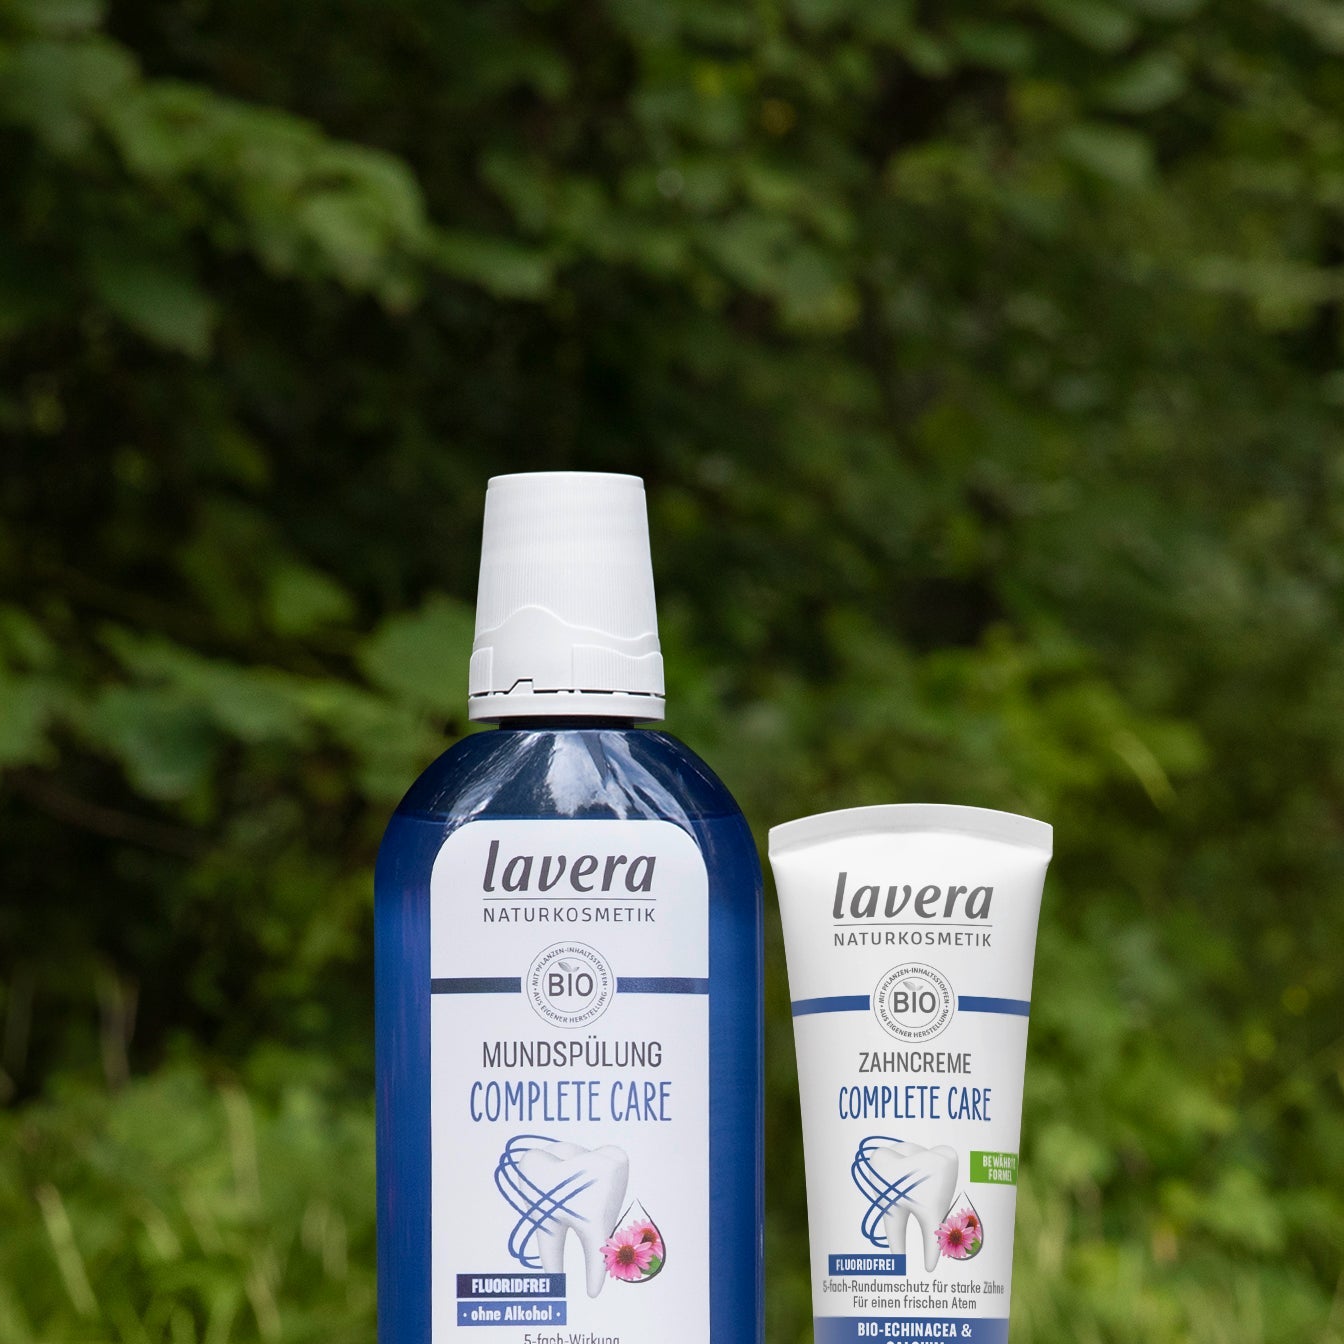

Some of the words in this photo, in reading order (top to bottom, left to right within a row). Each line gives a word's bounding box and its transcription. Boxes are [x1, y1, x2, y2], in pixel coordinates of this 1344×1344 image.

[483, 840, 656, 892] lavera
[833, 872, 994, 919] lavera
[483, 907, 655, 922] NATURKOSMETIK
[834, 931, 992, 947] NATURKOSMETIK
[536, 947, 608, 986] PFLANZEN-INHALTSSTOFFEN
[548, 973, 593, 996] BIO
[882, 967, 950, 1004] PFLANZEN-INHALTSSTOFFEN
[533, 991, 542, 1006] AUS
[540, 1005, 568, 1023] EIGENER
[569, 991, 607, 1023] HERSTELLUNG
[893, 991, 936, 1014] BIO
[880, 1008, 888, 1022] AUS
[886, 1020, 912, 1038] EIGENER
[913, 1009, 949, 1038] HERSTELLUNG
[483, 1035, 662, 1067] MUNDSPÜLUNG
[858, 1051, 972, 1074] ZAHNCREME
[470, 1081, 601, 1122] COMPLETE
[610, 1081, 672, 1122] CARE
[839, 1085, 941, 1120] COMPLETE
[947, 1086, 992, 1121] CARE
[836, 1258, 895, 1271] FLUORIDFREI
[471, 1278, 551, 1294] FLUORIDFREI
[822, 1279, 930, 1294] 5-fach-Rundumschutz
[932, 1280, 948, 1294] für
[951, 1280, 981, 1294] starke
[983, 1281, 1005, 1295] Zähne
[471, 1305, 501, 1321] ohne
[504, 1305, 552, 1321] Alkohol
[853, 1295, 868, 1308] Für
[871, 1296, 901, 1309] einen
[904, 1295, 948, 1309] frischen
[951, 1296, 977, 1310] Atem
[858, 1322, 957, 1337] BIO-ECHINACEA
[961, 1323, 972, 1338] &
